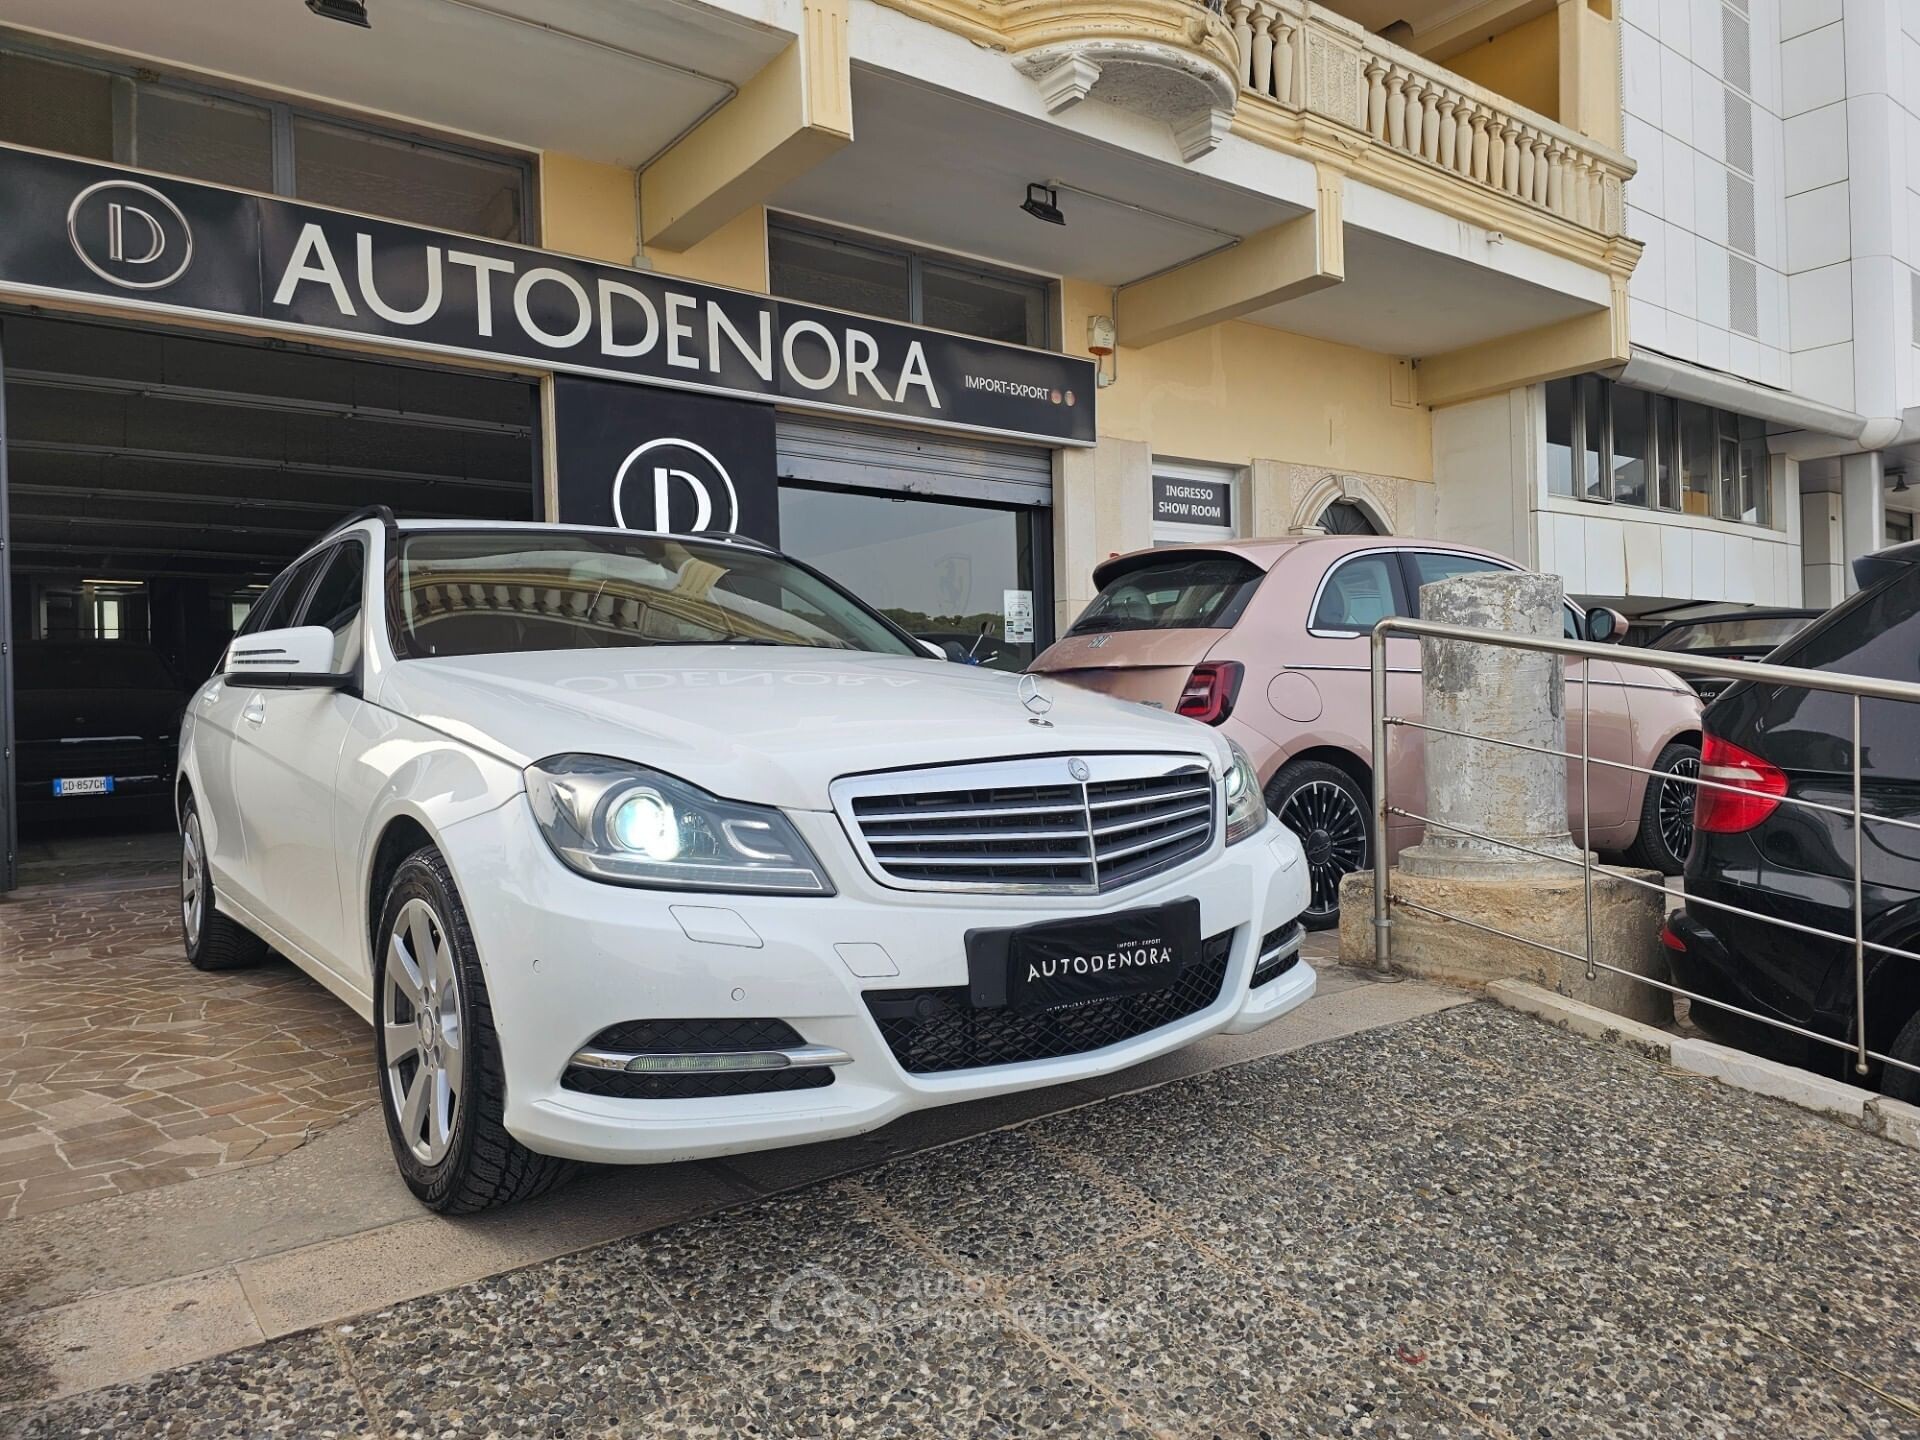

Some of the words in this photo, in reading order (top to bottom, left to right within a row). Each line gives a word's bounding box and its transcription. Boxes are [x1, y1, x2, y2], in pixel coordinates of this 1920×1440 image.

[273, 223, 941, 409] AUTODENORA
[965, 375, 1049, 400] IMPORT-EXPORT
[1166, 485, 1213, 500] INGRESSO
[1159, 502, 1189, 515] SHOW
[1191, 505, 1221, 518] ROOM
[1116, 941, 1137, 949] IMPORT
[1142, 938, 1161, 946] EXPORT
